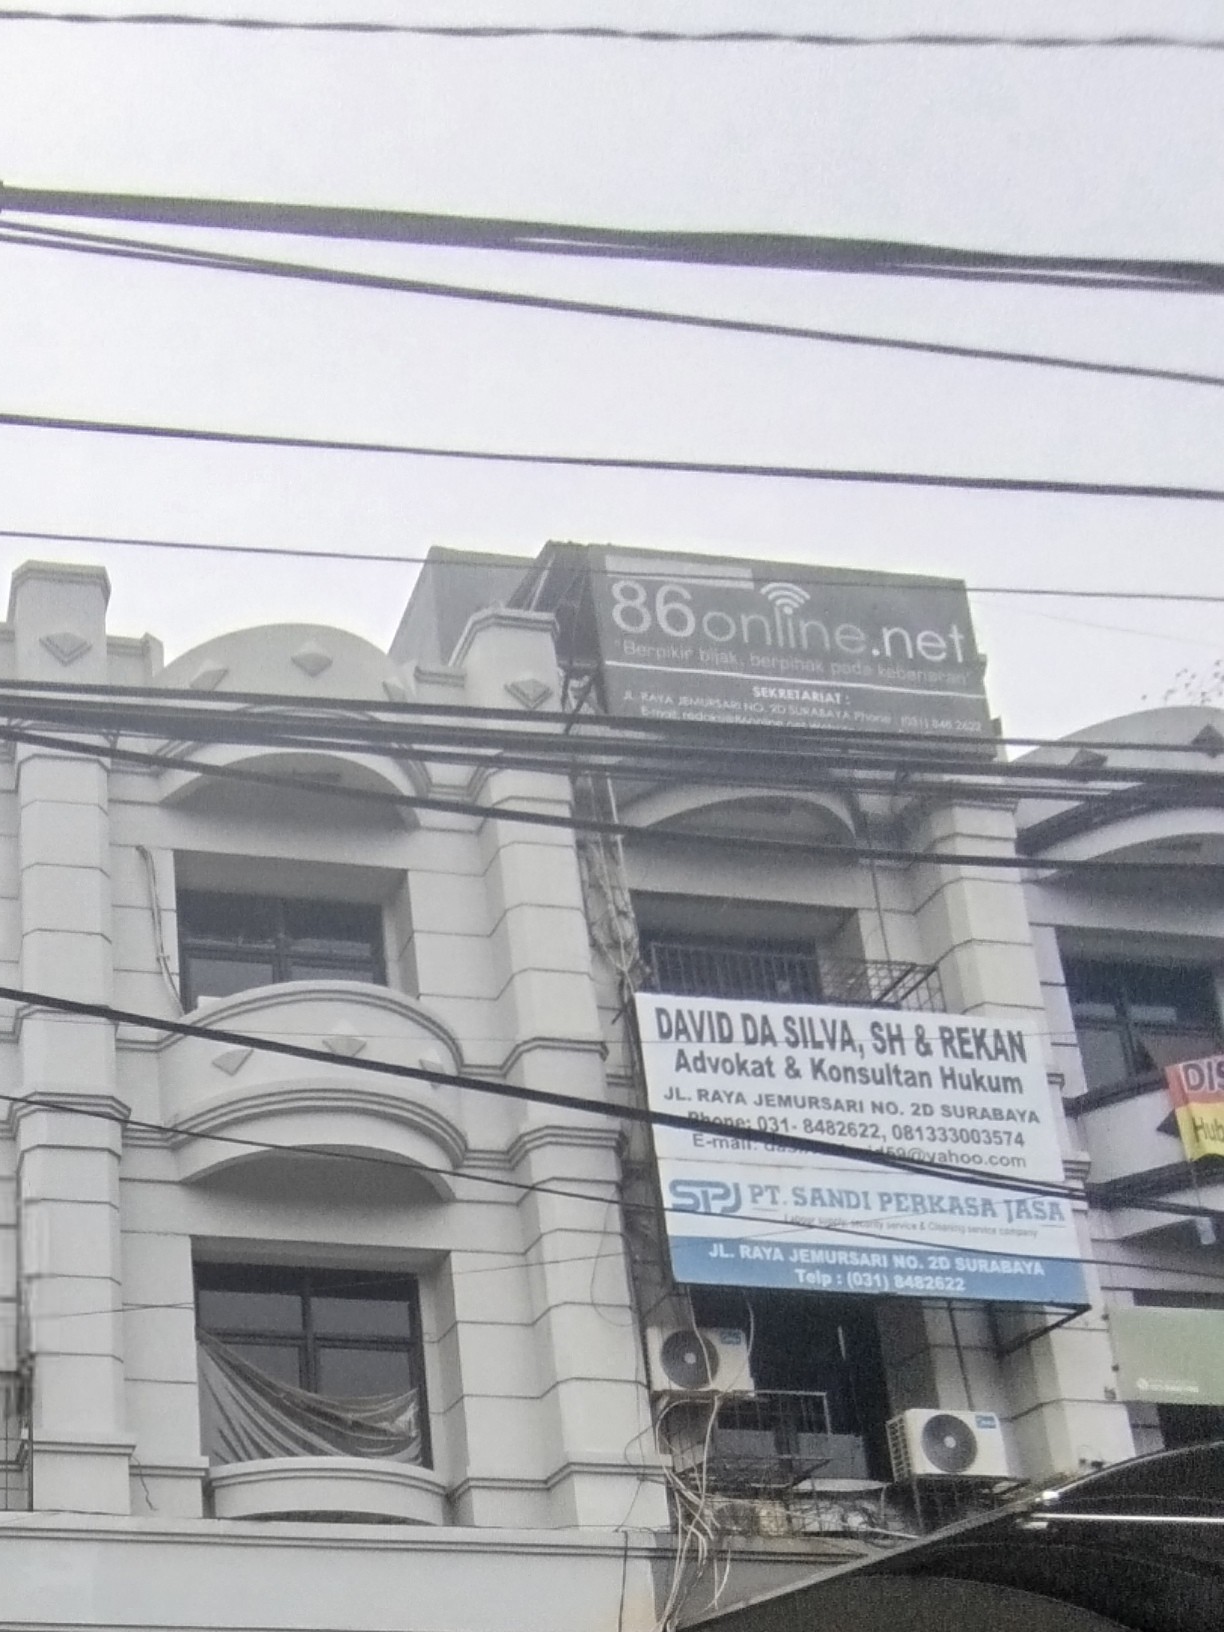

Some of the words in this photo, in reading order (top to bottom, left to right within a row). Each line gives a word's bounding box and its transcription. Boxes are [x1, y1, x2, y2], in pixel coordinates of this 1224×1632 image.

[612, 580, 965, 663] 86online.net
[752, 685, 841, 704] SEKRETARIAT
[655, 1007, 734, 1043] DAVID
[740, 1013, 778, 1047] DA
[783, 1015, 865, 1059] SILVA,
[870, 1021, 906, 1056] SH
[914, 1024, 933, 1057] &
[938, 1025, 1027, 1064] REKAN
[675, 1048, 776, 1078] Advokat
[784, 1055, 802, 1079] &
[810, 1057, 933, 1089] Konsultan
[939, 1066, 1024, 1094] Hukum
[664, 1086, 692, 1101] JL.
[697, 1088, 748, 1105] RAYA
[753, 1093, 864, 1114] JEMURSARI
[871, 1101, 904, 1116] NO.
[910, 1102, 935, 1117] 2D
[940, 1104, 1041, 1124] SURABAYA
[803, 1118, 887, 1143] 8482622,
[892, 1125, 1026, 1148] 081333003574
[792, 1186, 872, 1211] SANDI
[877, 1191, 999, 1218] PERKASA
[1004, 1199, 1065, 1223] JASA
[709, 1243, 734, 1259] JL.
[739, 1245, 785, 1262] RAYA
[789, 1247, 888, 1268] JEMURSARI
[893, 1255, 924, 1270] NO.
[928, 1256, 951, 1270] 2D
[955, 1258, 1045, 1275] SURABAYA
[794, 1269, 832, 1287] Telp
[847, 1272, 888, 1291] (031)
